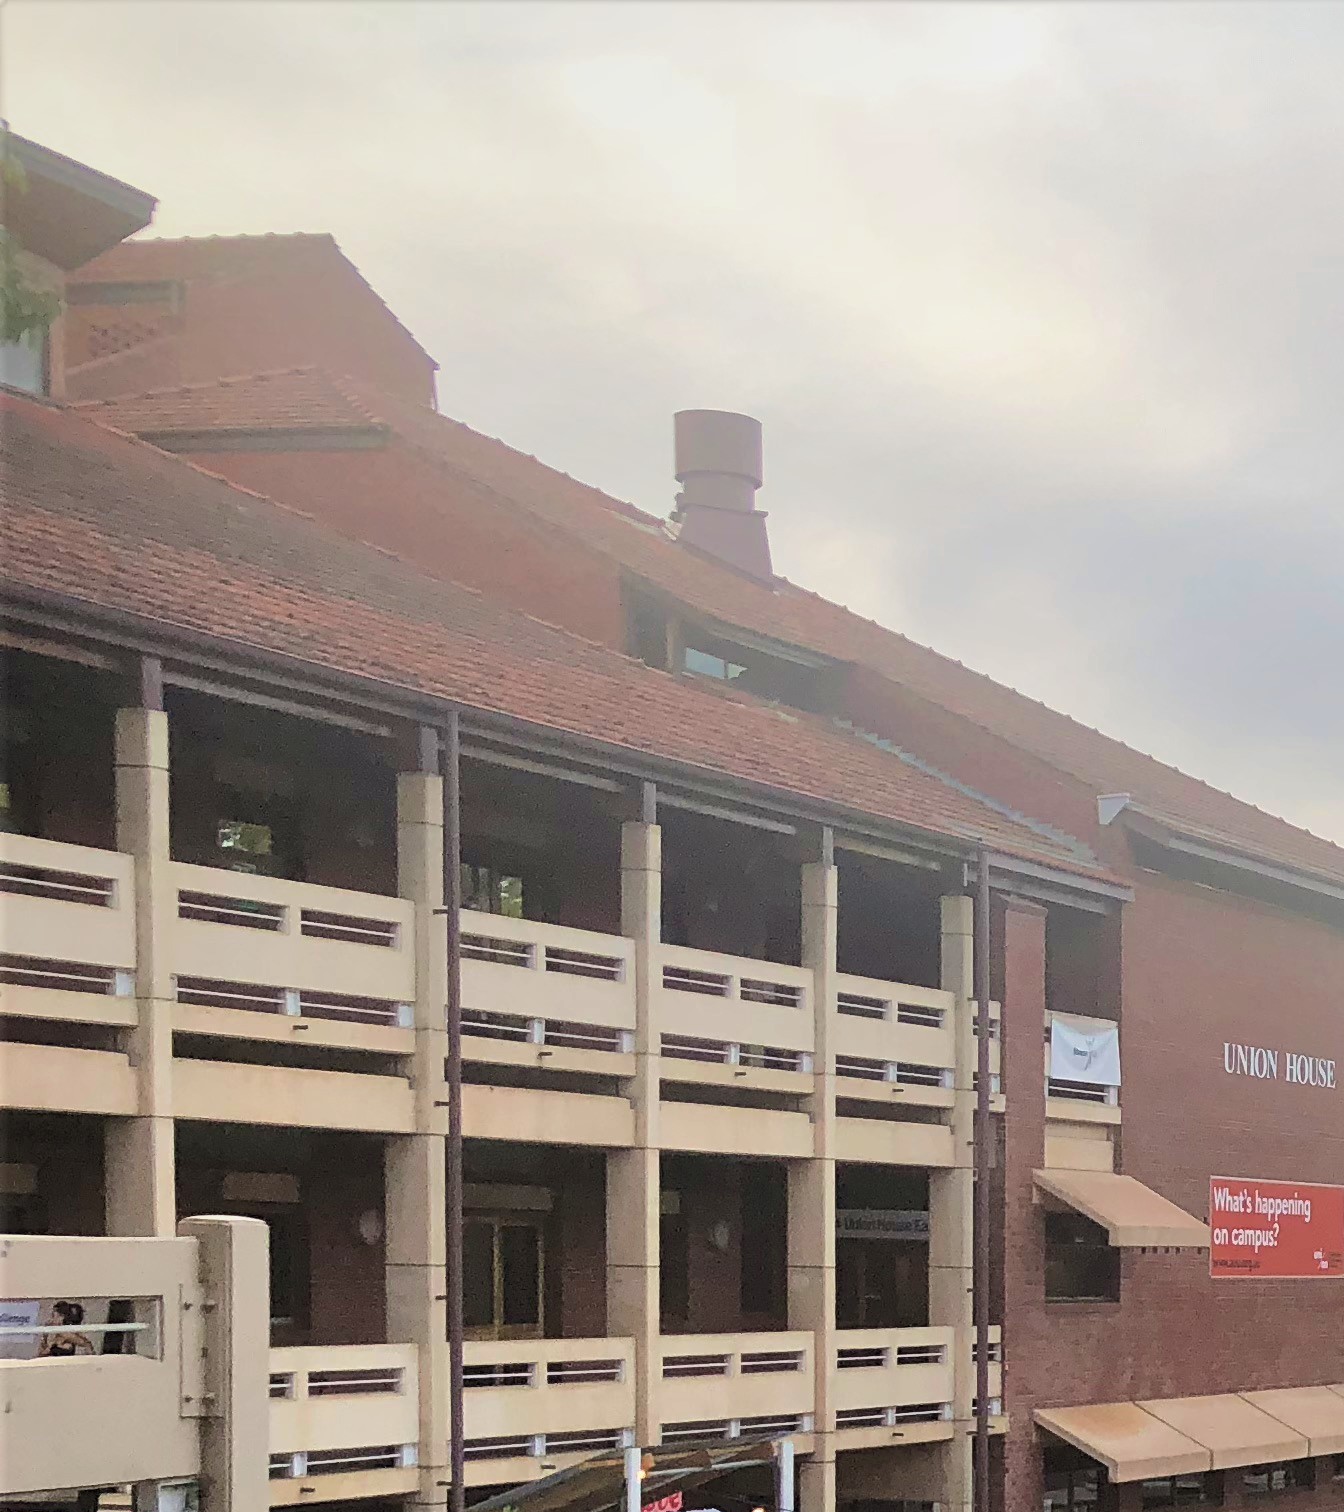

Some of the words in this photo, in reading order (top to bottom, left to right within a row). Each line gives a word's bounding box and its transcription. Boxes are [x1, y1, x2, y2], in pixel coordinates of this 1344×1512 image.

[1223, 1042, 1278, 1079] UNION
[1285, 1052, 1336, 1088] HOUSE
[1213, 1186, 1252, 1213] What's
[1255, 1189, 1311, 1222] happening
[1213, 1228, 1228, 1245] on
[1231, 1222, 1280, 1253] campus?
